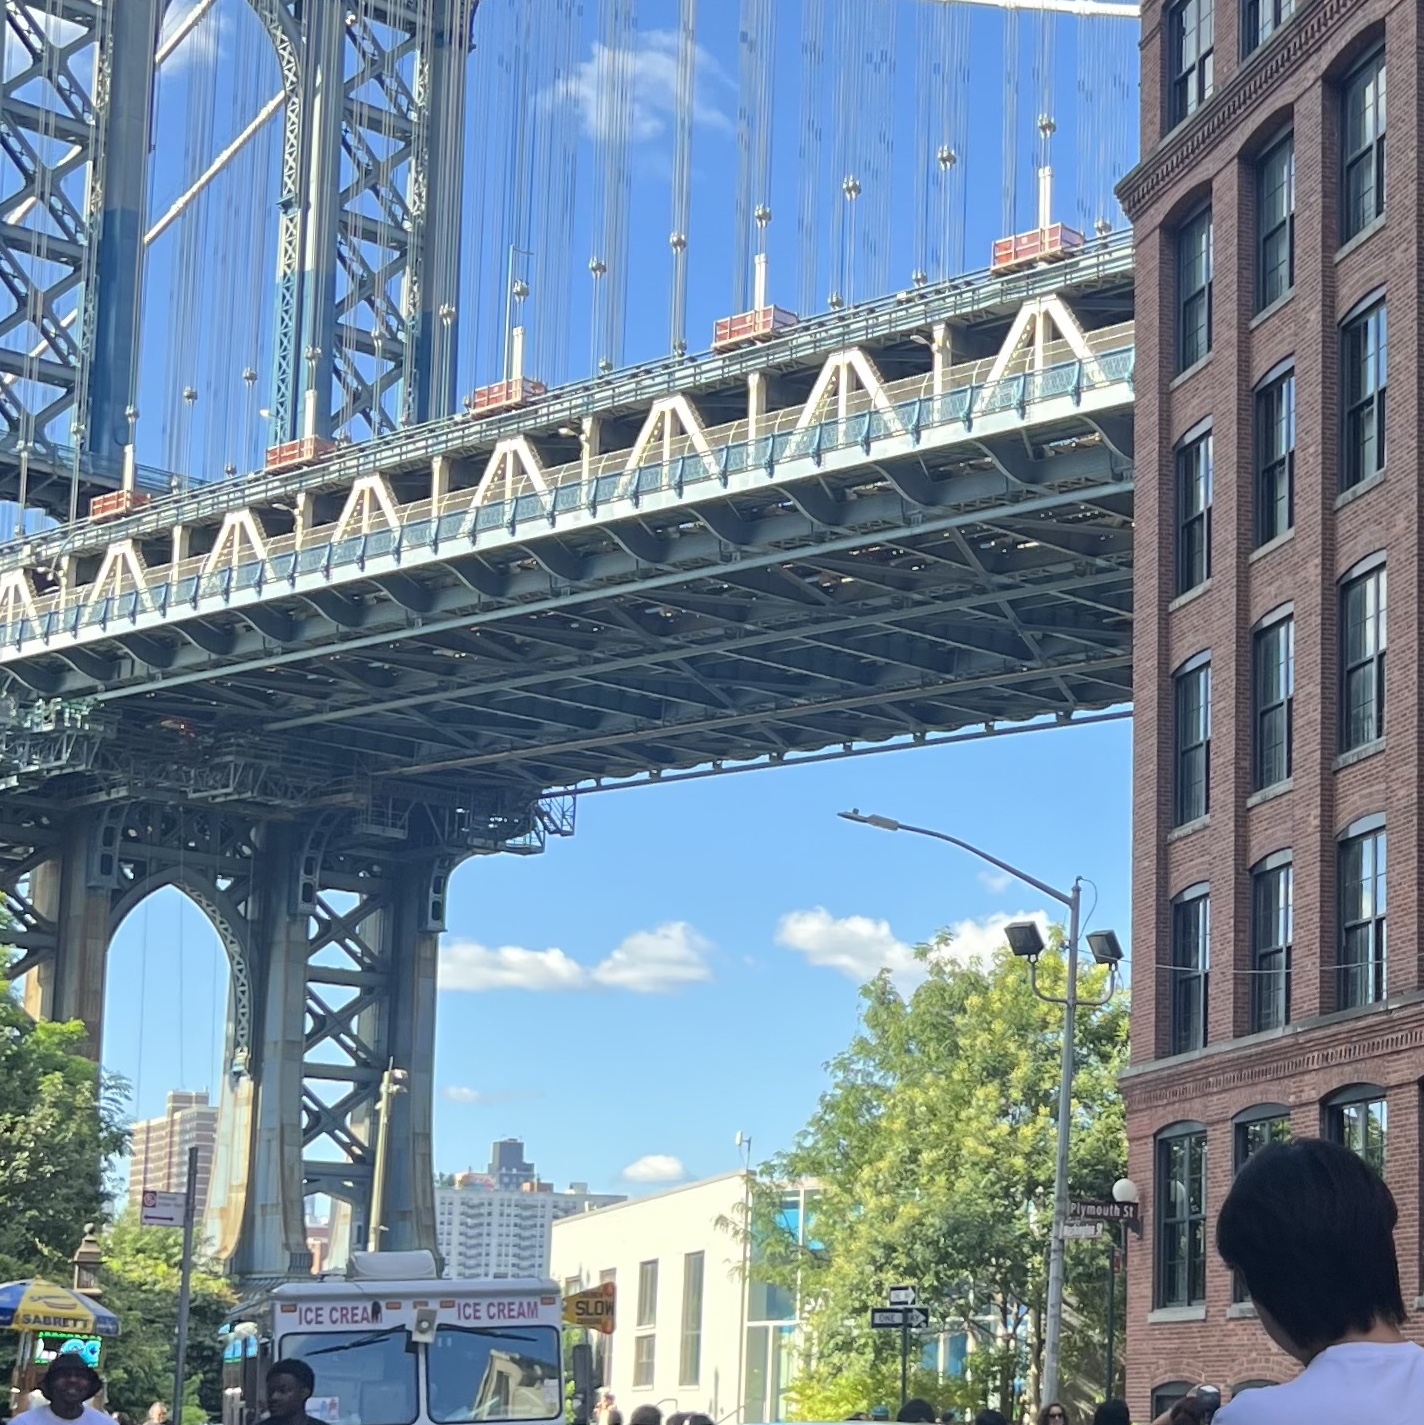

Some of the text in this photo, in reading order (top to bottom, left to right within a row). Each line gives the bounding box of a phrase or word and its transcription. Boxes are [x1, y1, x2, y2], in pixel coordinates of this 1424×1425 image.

[1070, 1202, 1134, 1220] Plymouth St
[299, 1306, 324, 1326] ICE
[456, 1300, 539, 1321] ICE CREAM
[575, 1300, 615, 1316] SLOW
[23, 1313, 88, 1328] SABRETT
[879, 1313, 896, 1323] ONE
